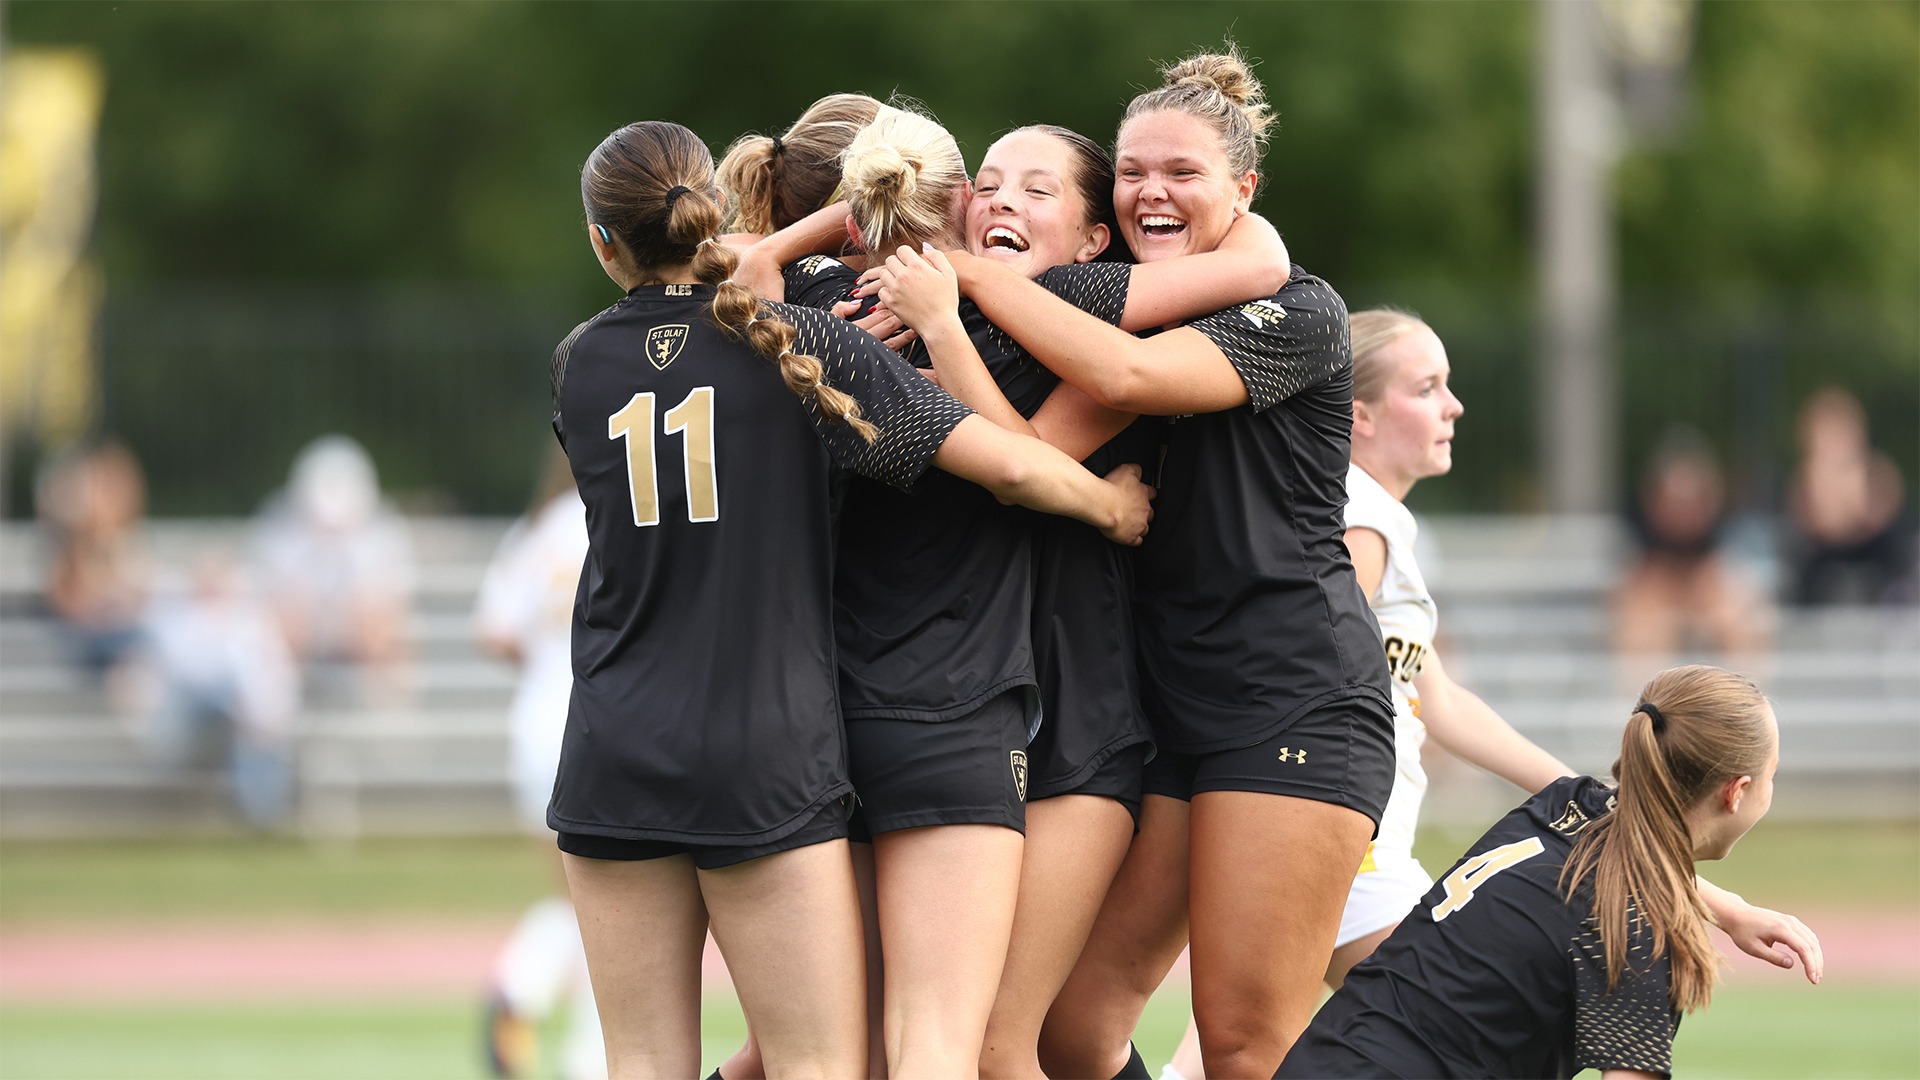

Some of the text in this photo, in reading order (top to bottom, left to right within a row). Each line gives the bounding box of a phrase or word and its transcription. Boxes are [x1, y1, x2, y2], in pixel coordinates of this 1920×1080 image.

[665, 284, 692, 296] OLES
[1241, 304, 1286, 325] MIAC
[651, 329, 684, 341] ST. OLAF
[608, 385, 719, 527] 11
[1431, 836, 1546, 923] 4
